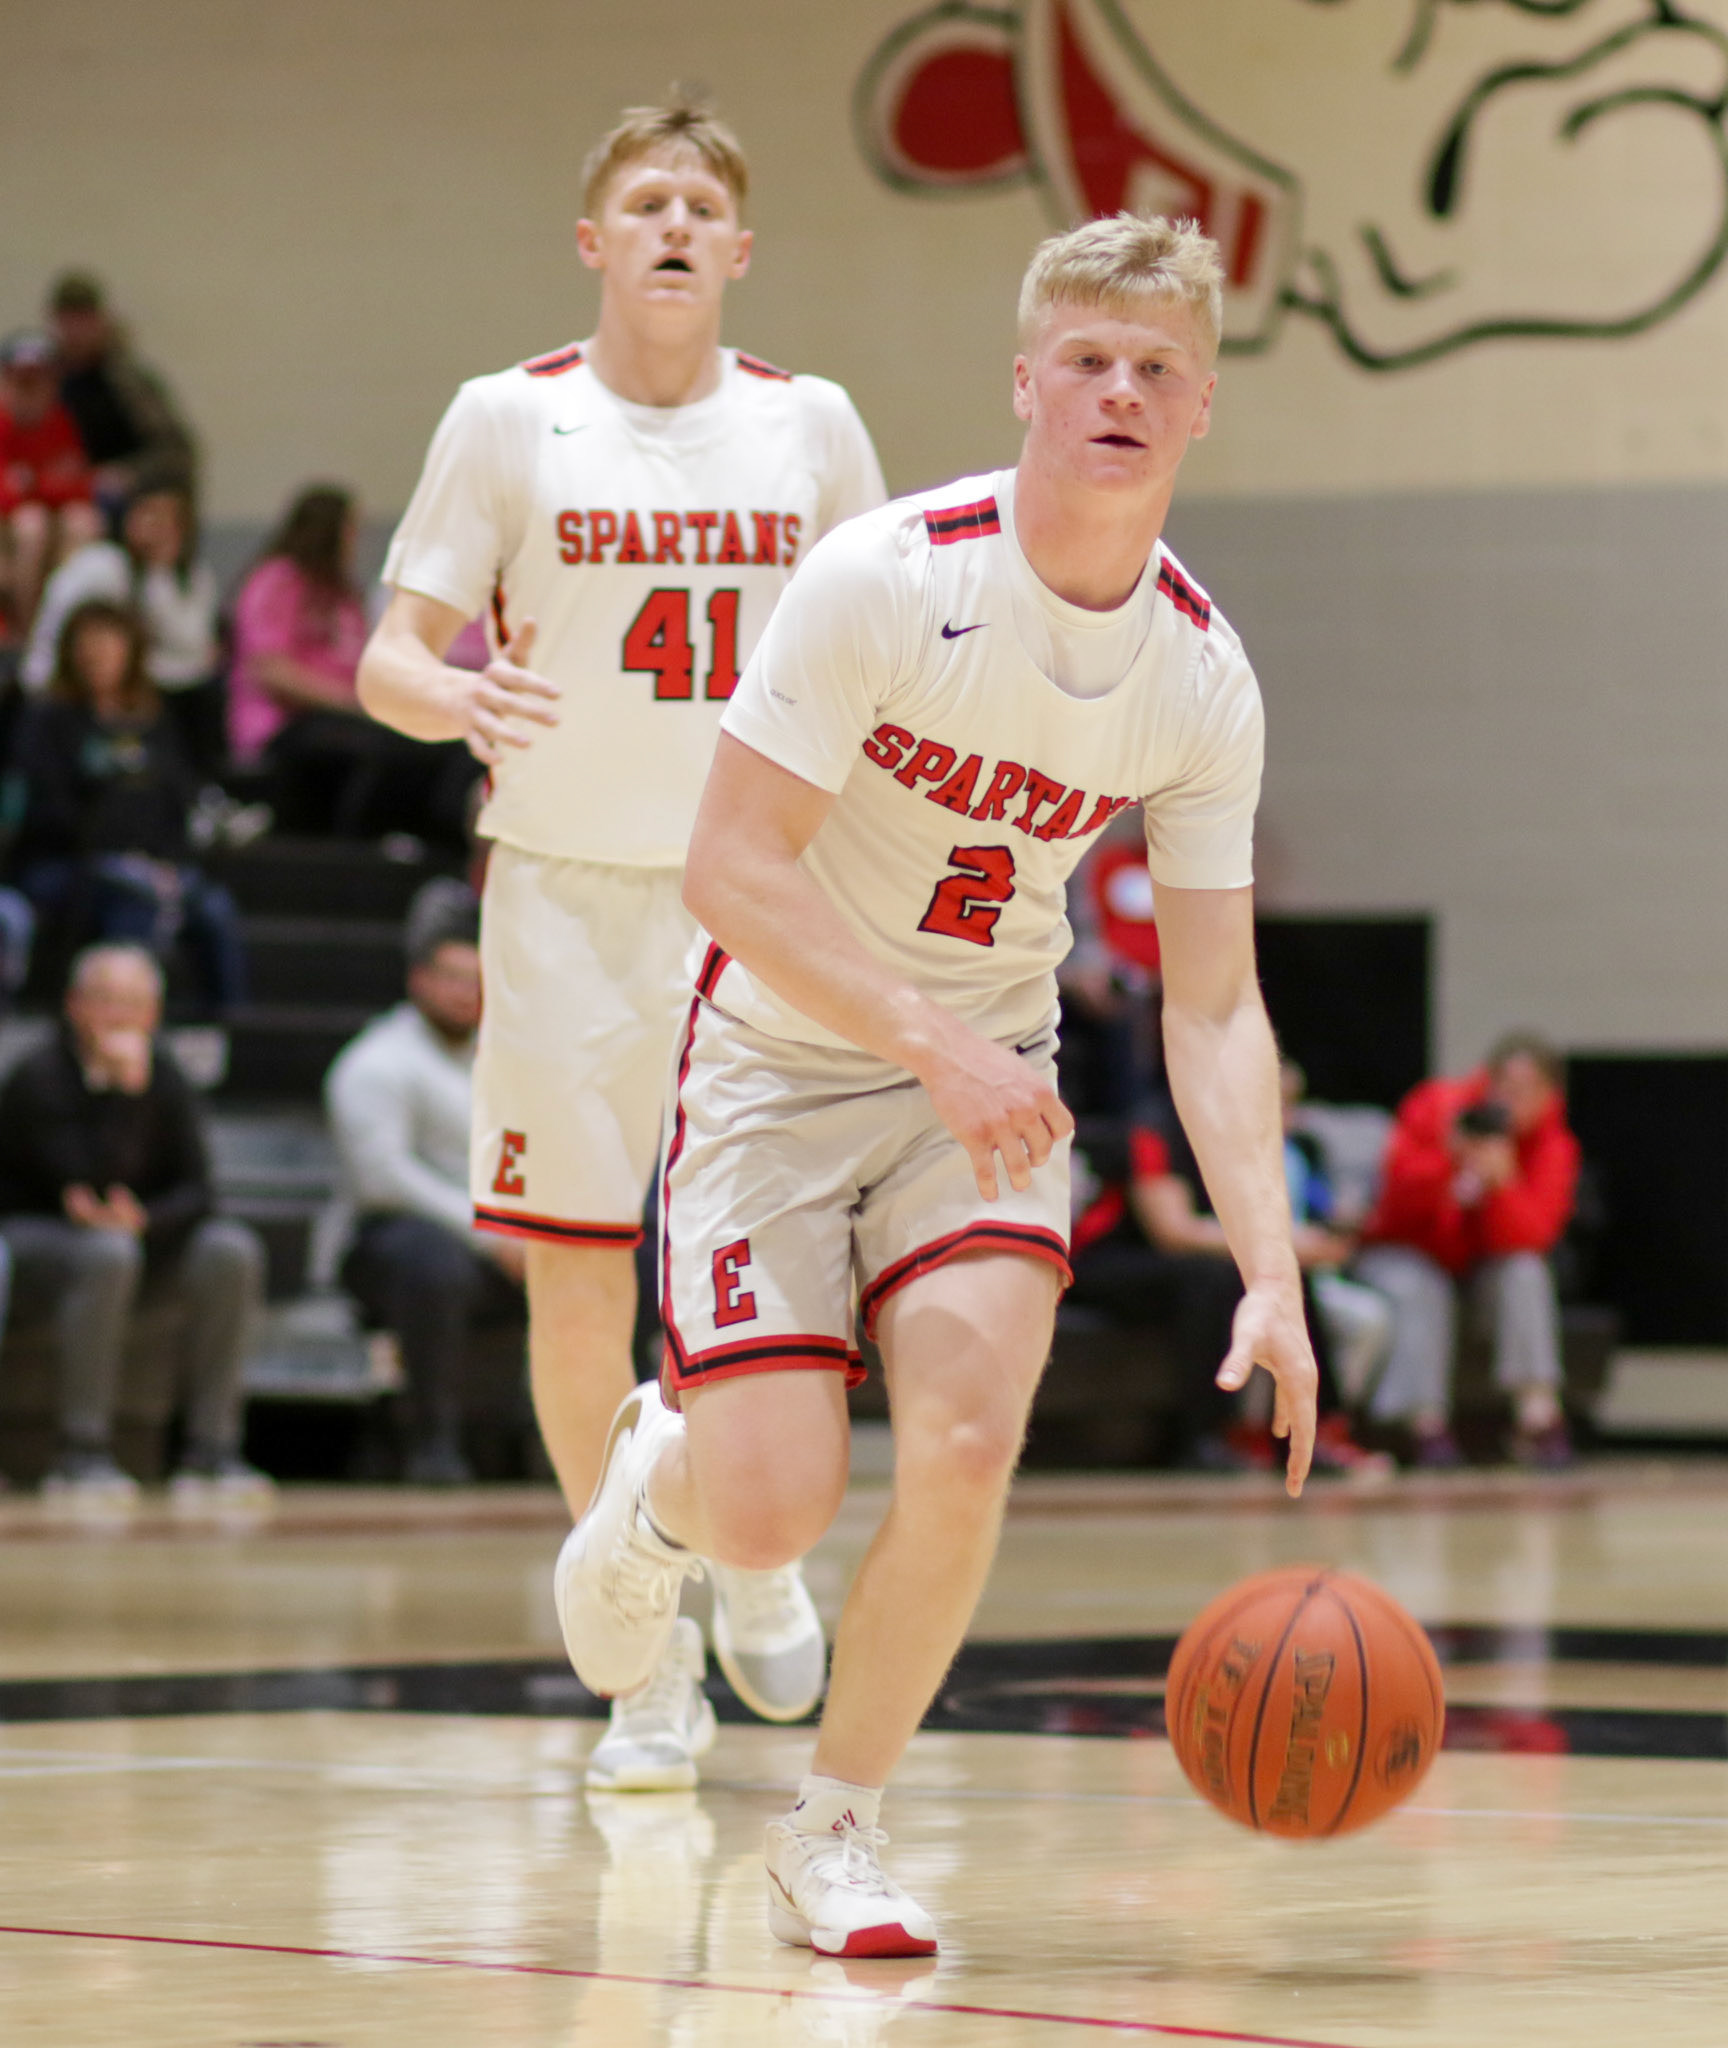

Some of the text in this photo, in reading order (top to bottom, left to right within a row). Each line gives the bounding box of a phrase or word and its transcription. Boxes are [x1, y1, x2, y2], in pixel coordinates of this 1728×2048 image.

[556, 509, 803, 567] SPARTANS
[621, 586, 741, 701] 41
[862, 722, 1139, 843] SPARTAN
[916, 844, 1017, 948] 2
[491, 1129, 527, 1197] E
[712, 1237, 759, 1330] E
